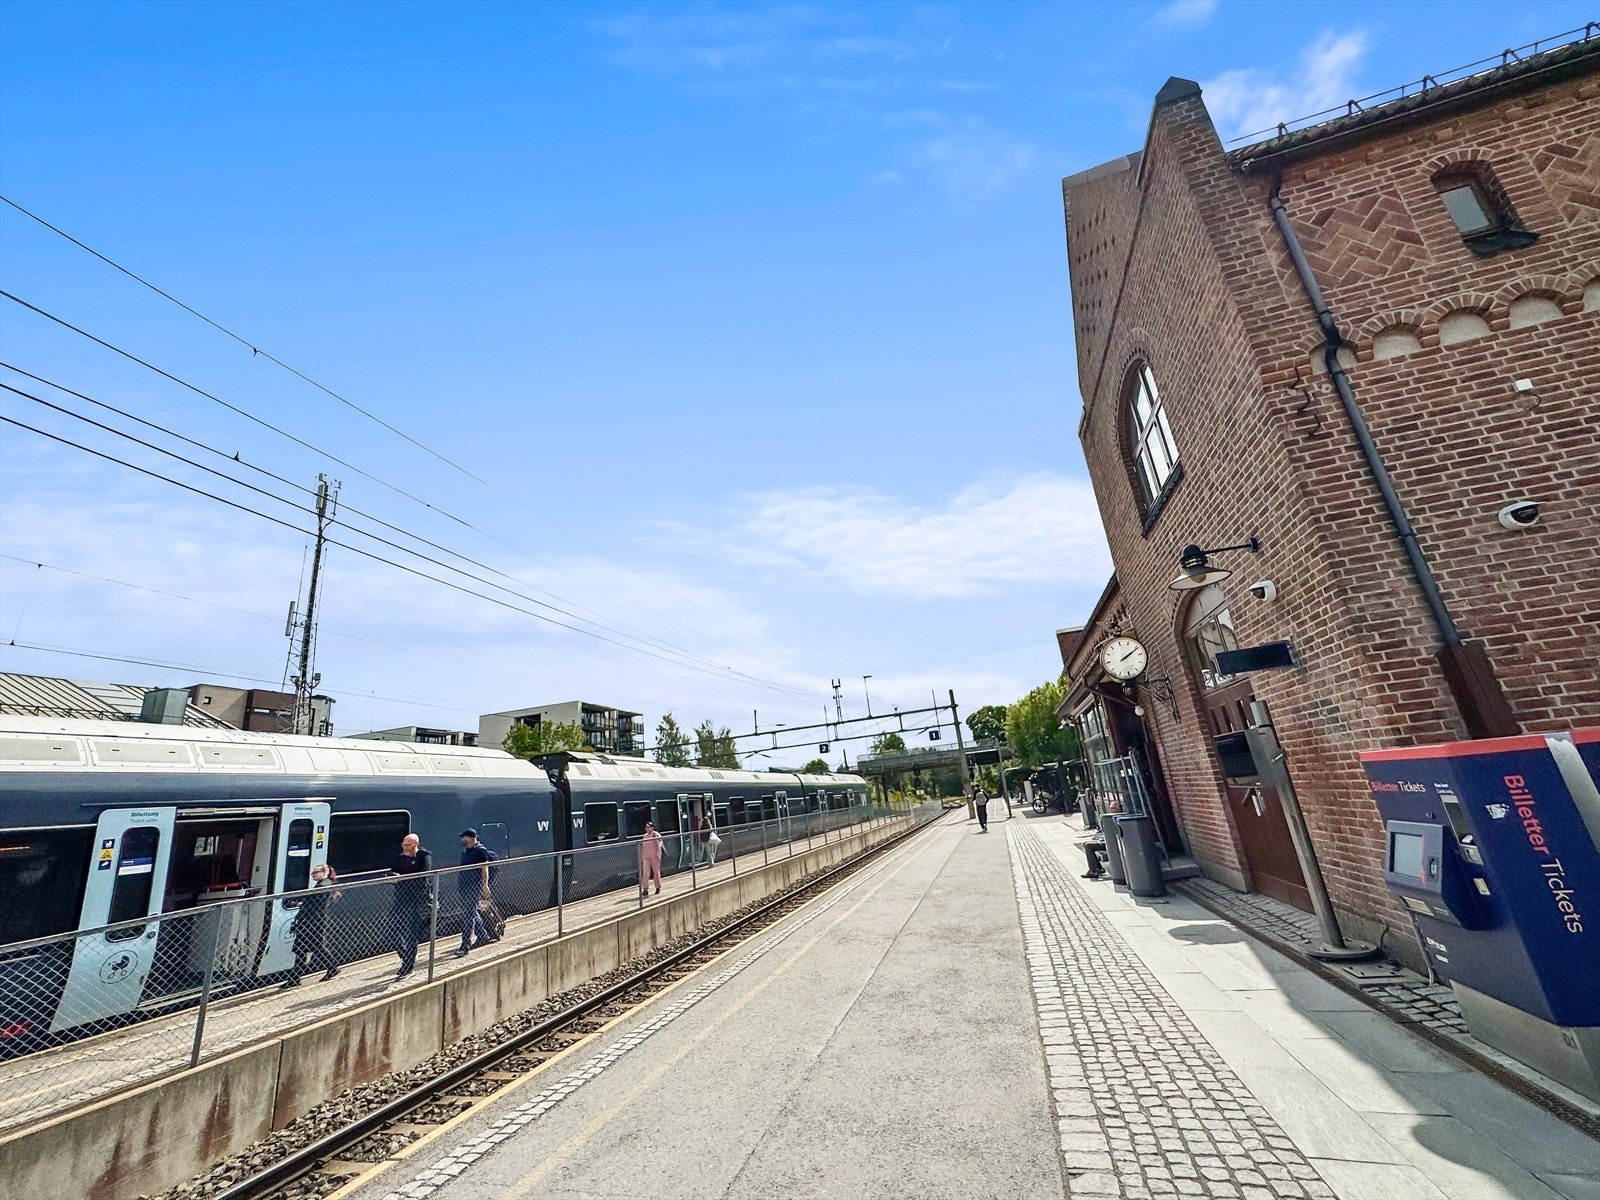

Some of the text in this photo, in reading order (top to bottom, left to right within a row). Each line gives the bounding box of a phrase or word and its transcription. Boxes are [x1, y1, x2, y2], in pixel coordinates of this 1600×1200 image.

[1398, 781, 1426, 792] Tickets
[1504, 774, 1583, 933] Billetter Tickets
